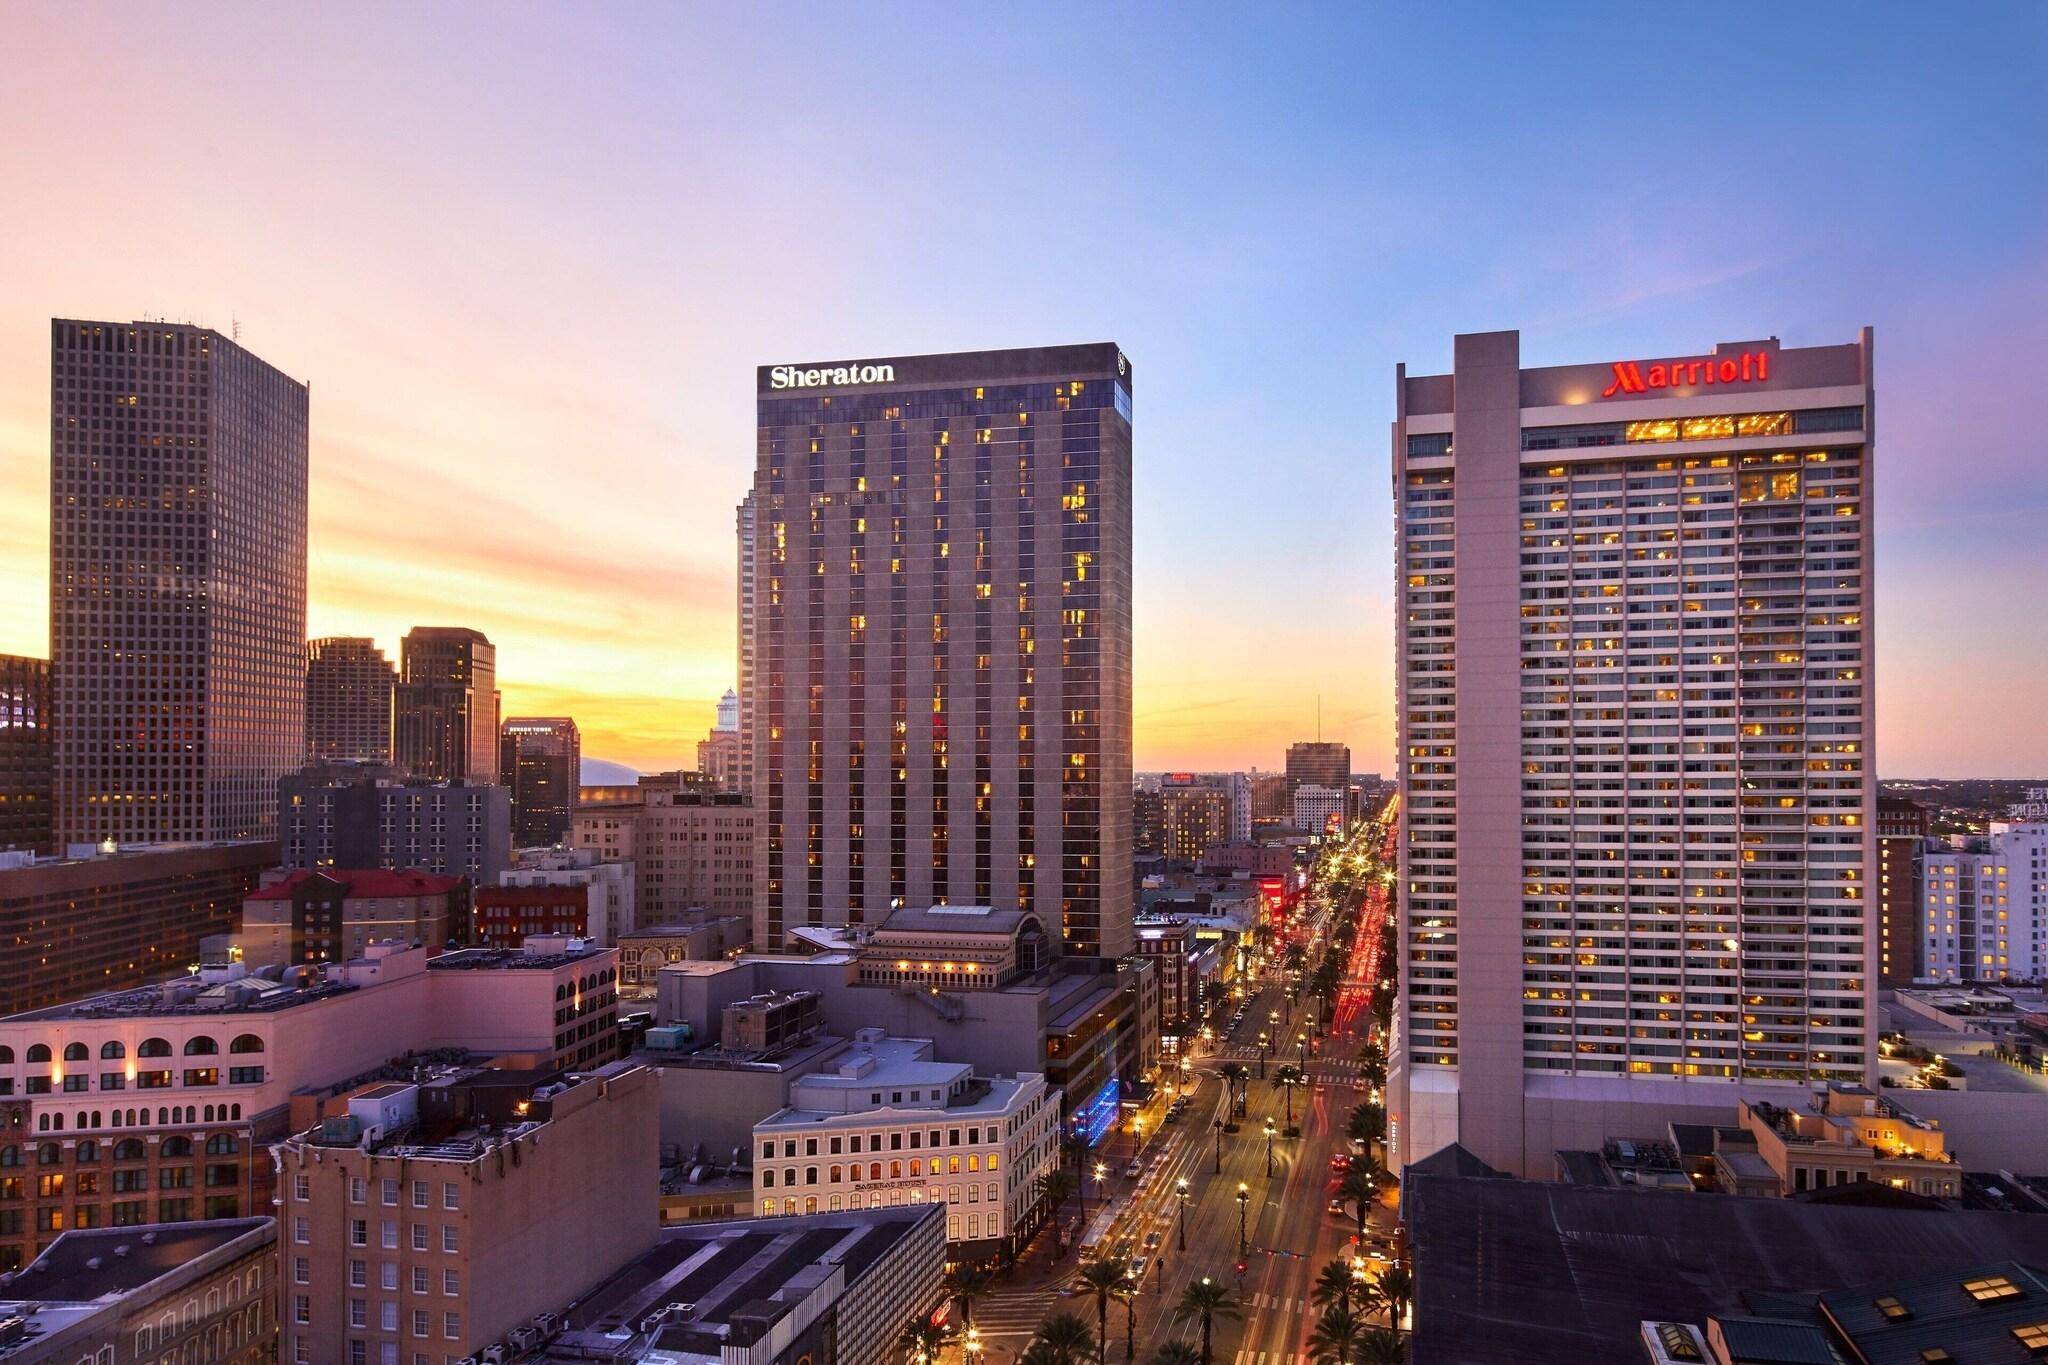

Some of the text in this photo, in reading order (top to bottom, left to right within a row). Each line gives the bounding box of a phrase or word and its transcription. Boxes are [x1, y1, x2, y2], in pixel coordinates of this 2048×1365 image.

[771, 365, 894, 389] Sheraton
[1603, 351, 1767, 397] Marriott
[855, 1179, 927, 1190] SAZERAC HOUSE
